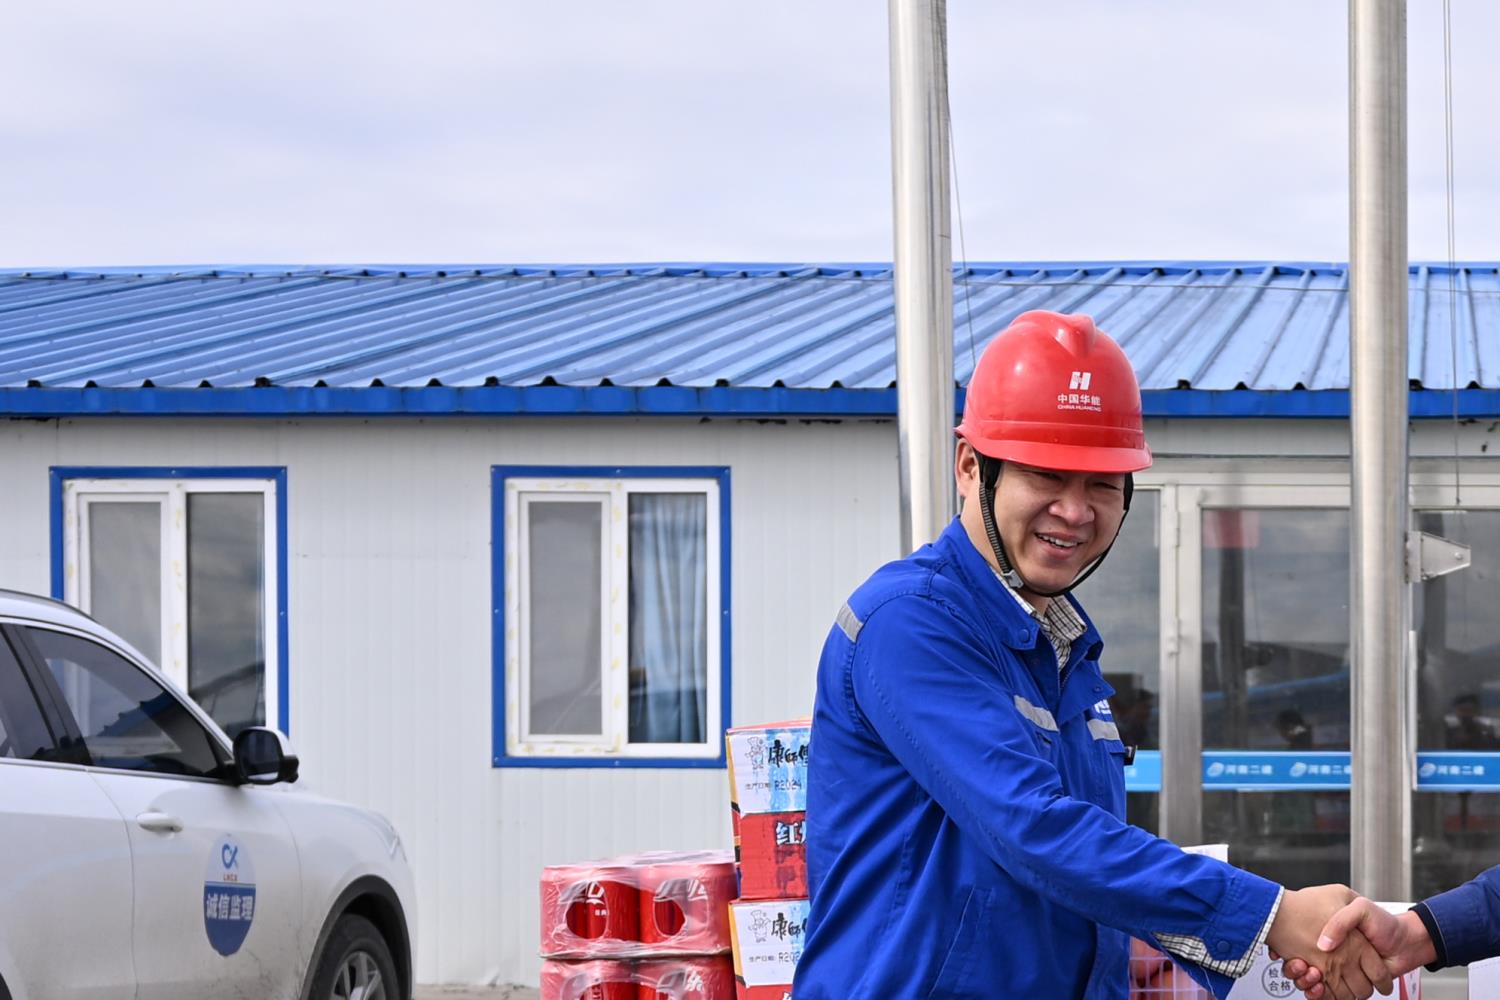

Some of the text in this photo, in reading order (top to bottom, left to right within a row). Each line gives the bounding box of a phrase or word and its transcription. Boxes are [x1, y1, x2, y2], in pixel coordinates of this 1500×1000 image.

[1057, 393, 1101, 406] 中国华能
[776, 821, 806, 845] 红
[206, 892, 253, 920] 诚信监理
[771, 912, 808, 941] 康師
[1268, 980, 1291, 992] 合格
